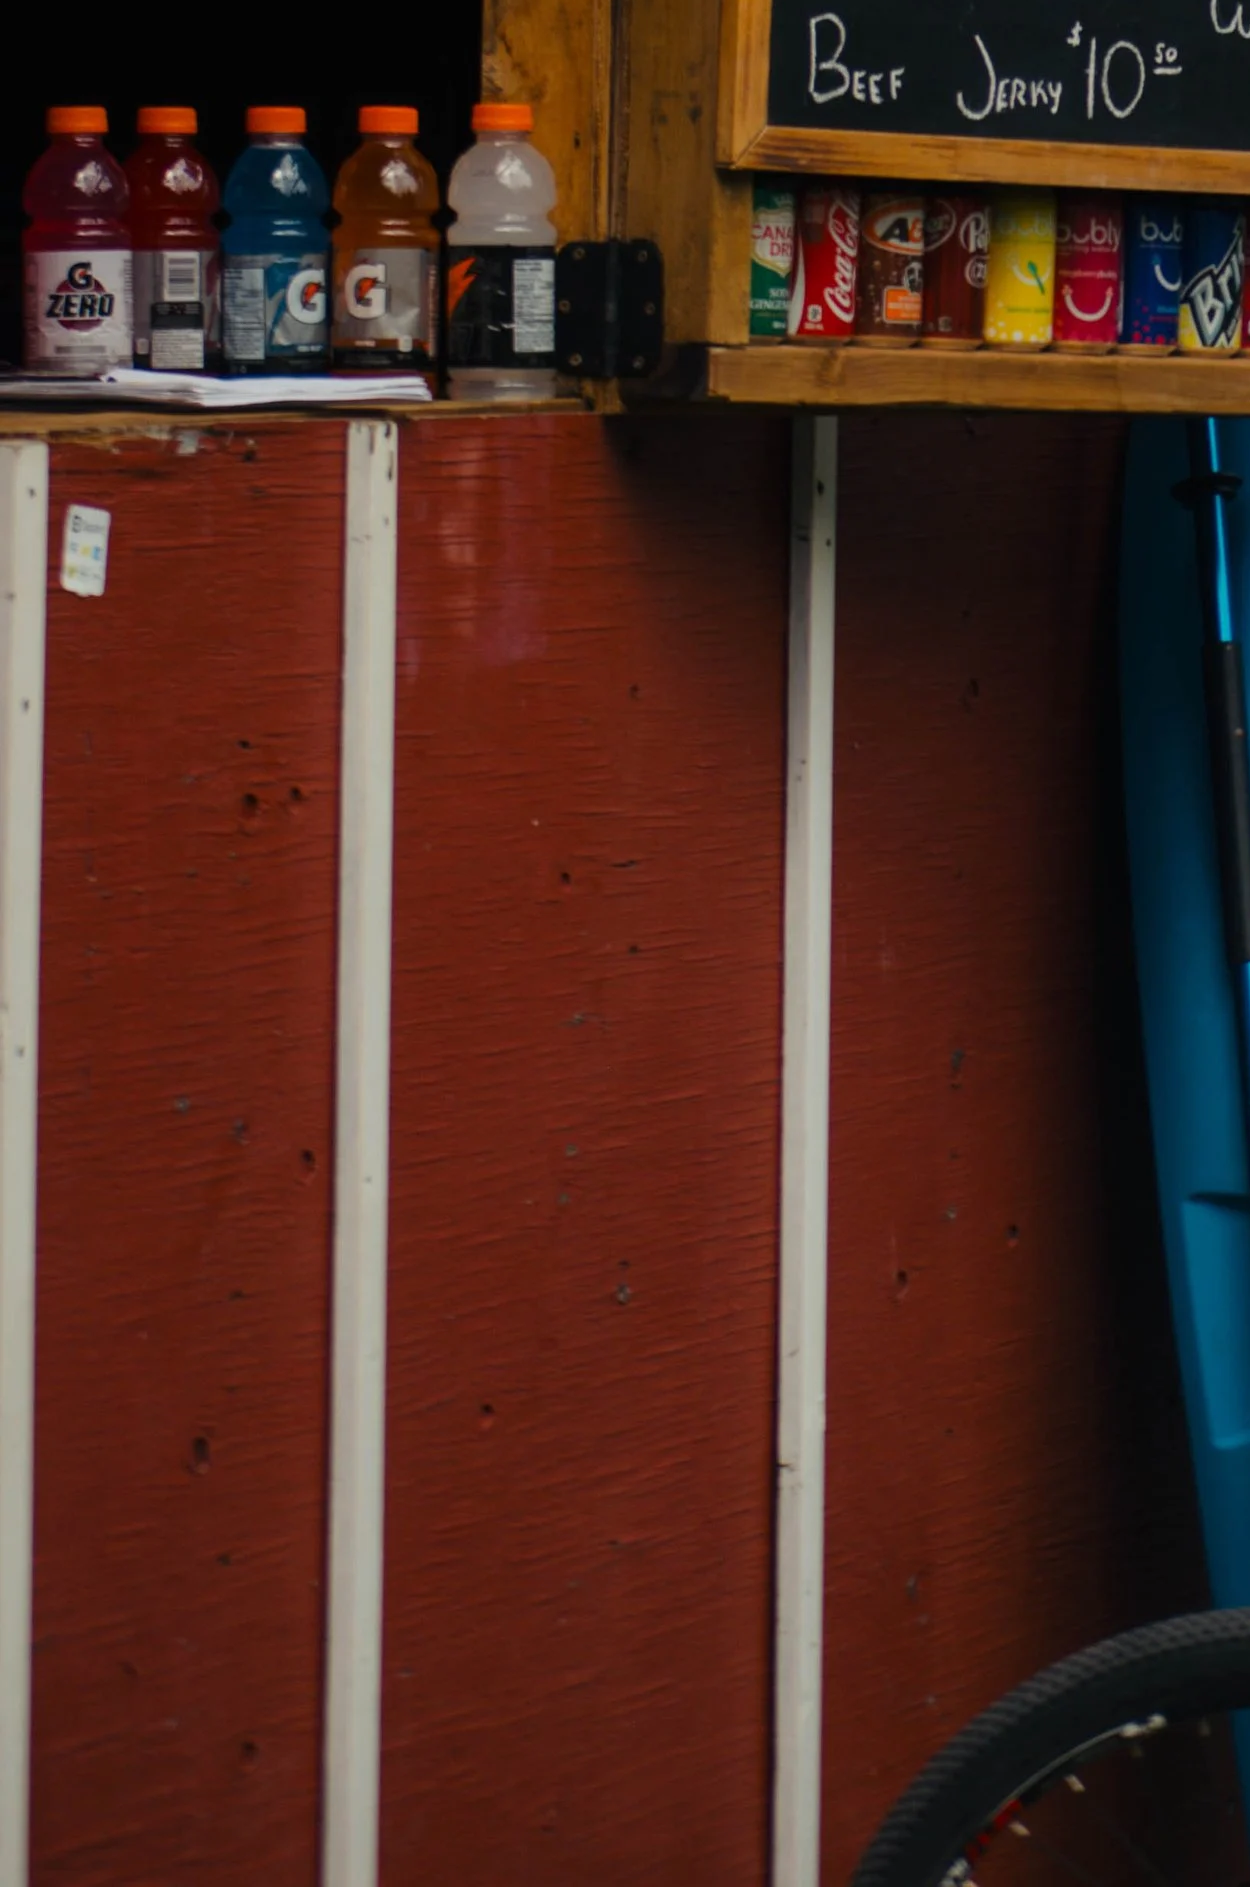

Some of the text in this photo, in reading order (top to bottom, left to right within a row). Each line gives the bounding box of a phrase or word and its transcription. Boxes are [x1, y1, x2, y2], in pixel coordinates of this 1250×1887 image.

[808, 12, 905, 105] BEEF
[67, 261, 94, 290] G
[344, 263, 388, 320] G
[46, 293, 116, 318] ZERO
